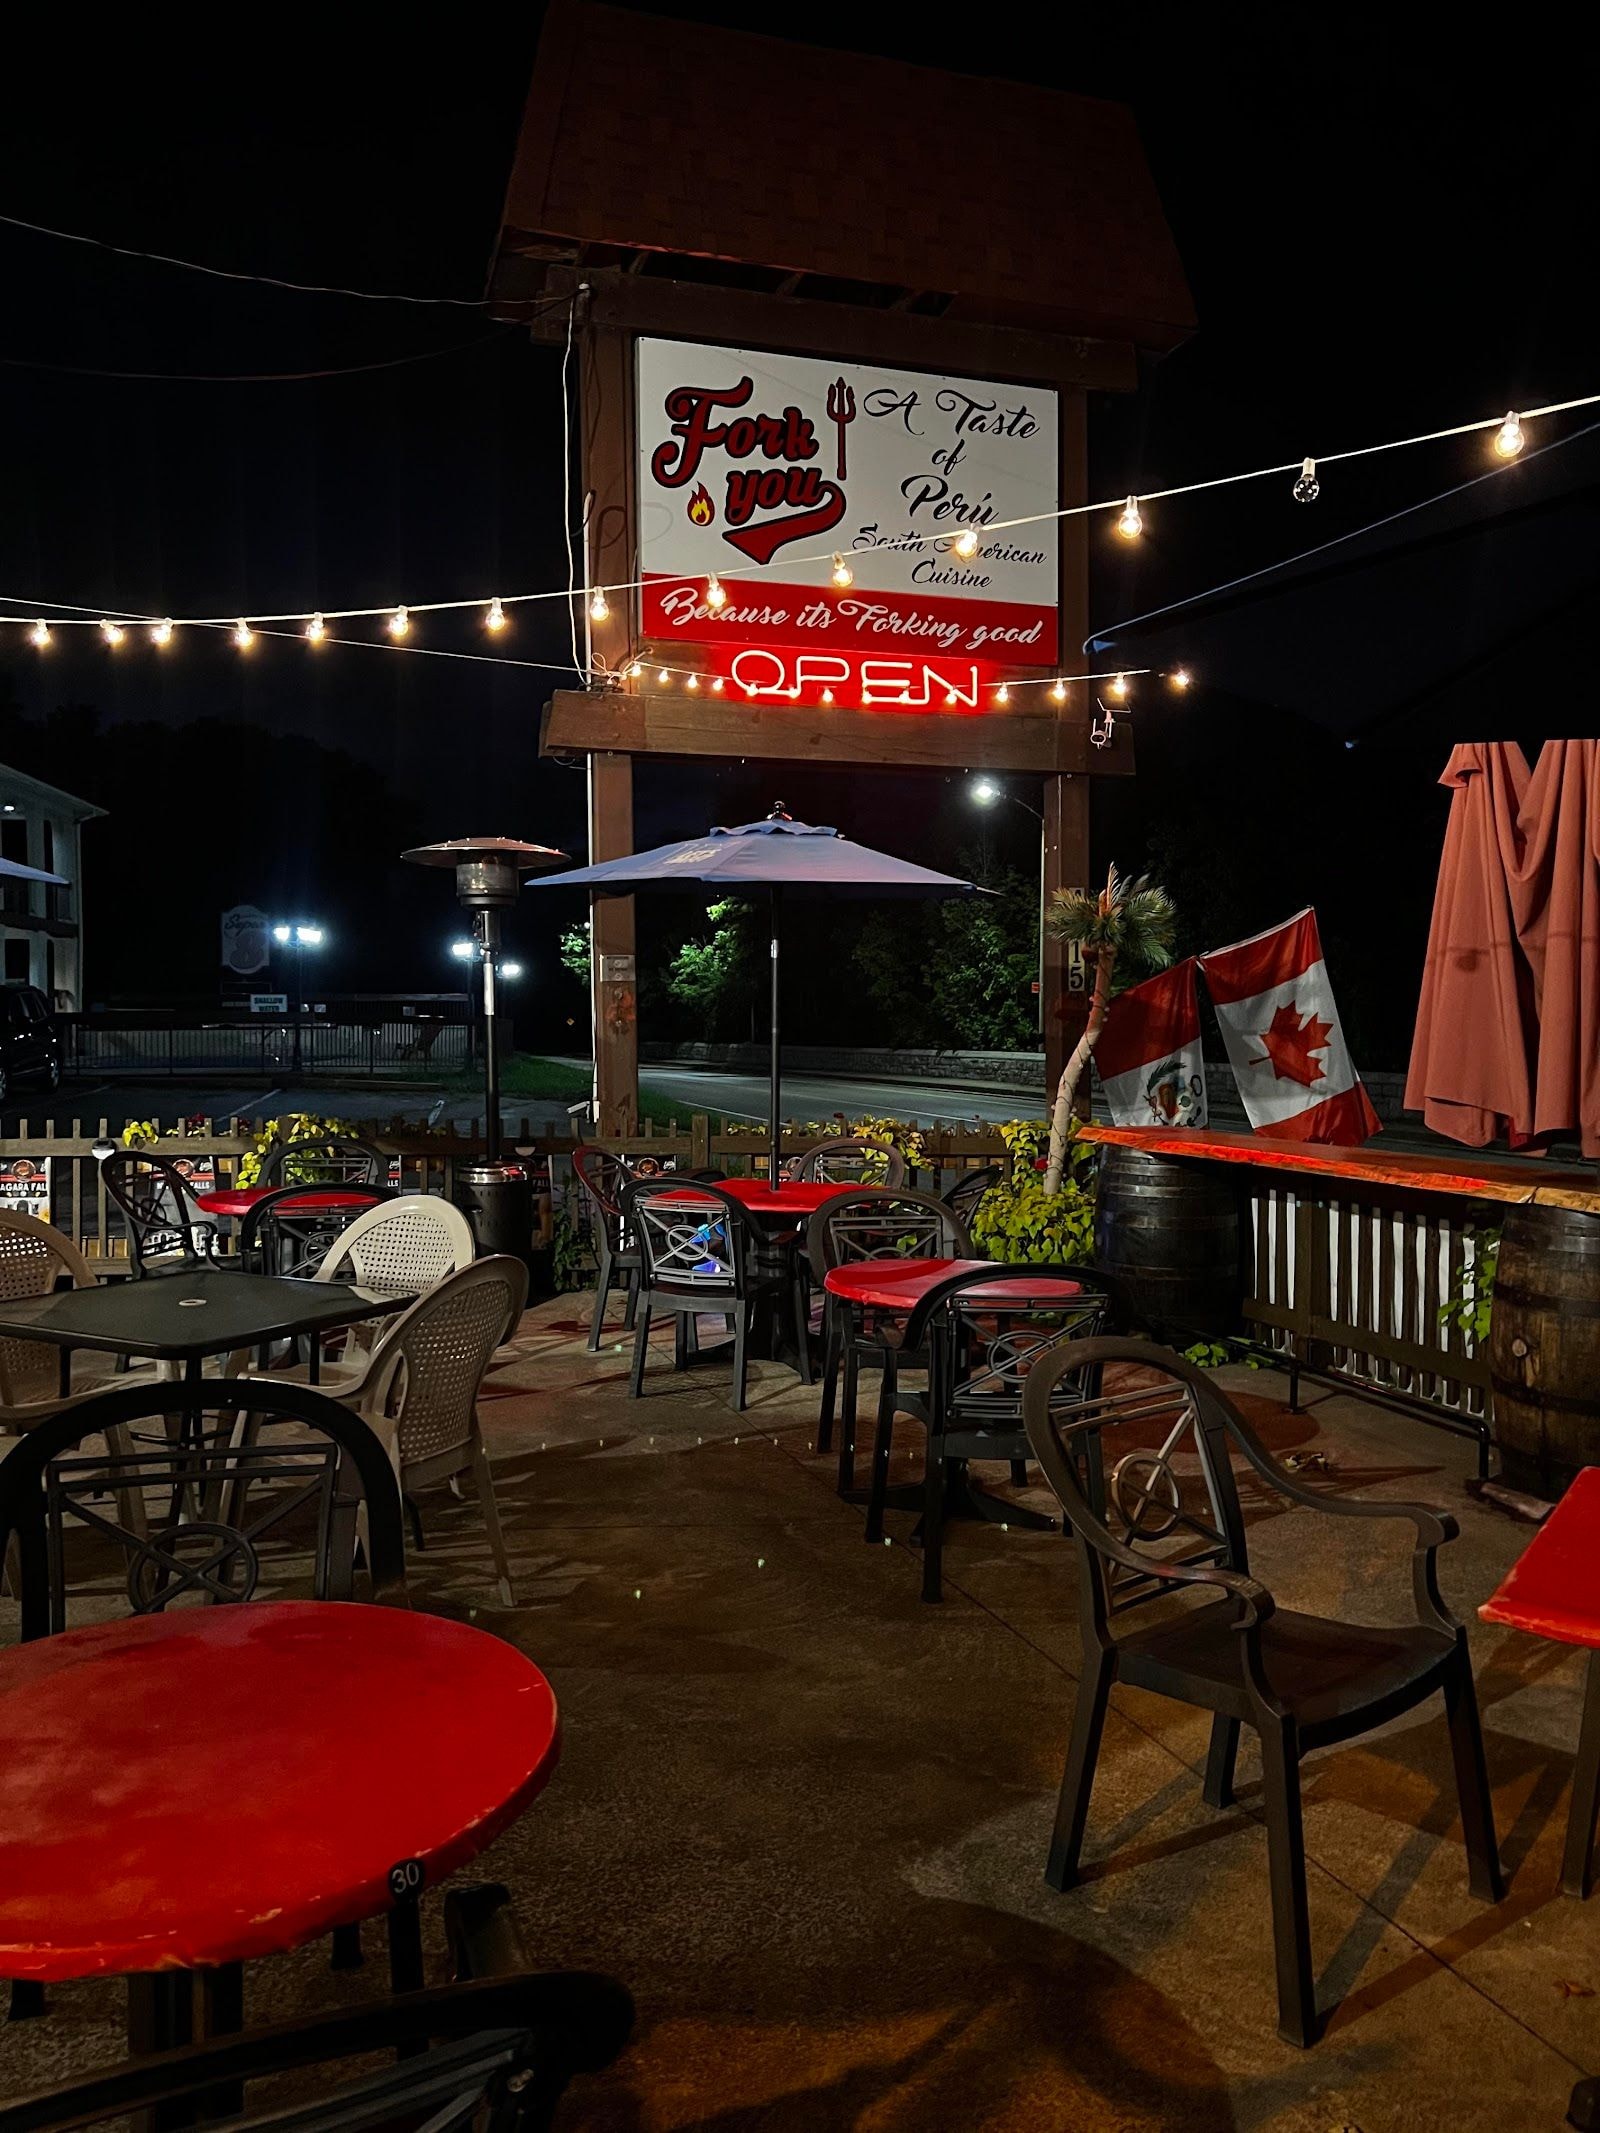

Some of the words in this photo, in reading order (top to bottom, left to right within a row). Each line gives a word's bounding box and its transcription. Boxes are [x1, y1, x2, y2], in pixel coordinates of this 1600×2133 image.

[652, 376, 819, 488] Fork
[864, 389, 925, 435] A
[936, 390, 1040, 438] Taste
[932, 439, 966, 475] of
[725, 466, 823, 526] you
[901, 475, 999, 525] Perú
[852, 523, 928, 553] South
[934, 538, 1046, 564] erican
[912, 558, 992, 587] Cuisine
[660, 587, 790, 626] Because
[796, 601, 836, 628] its
[837, 599, 967, 648] Forking
[965, 620, 1043, 650] good
[731, 650, 978, 707] OPEN
[31, 1182, 47, 1192] FAL
[387, 1179, 399, 1187] LLS
[392, 1862, 420, 1894] 30
